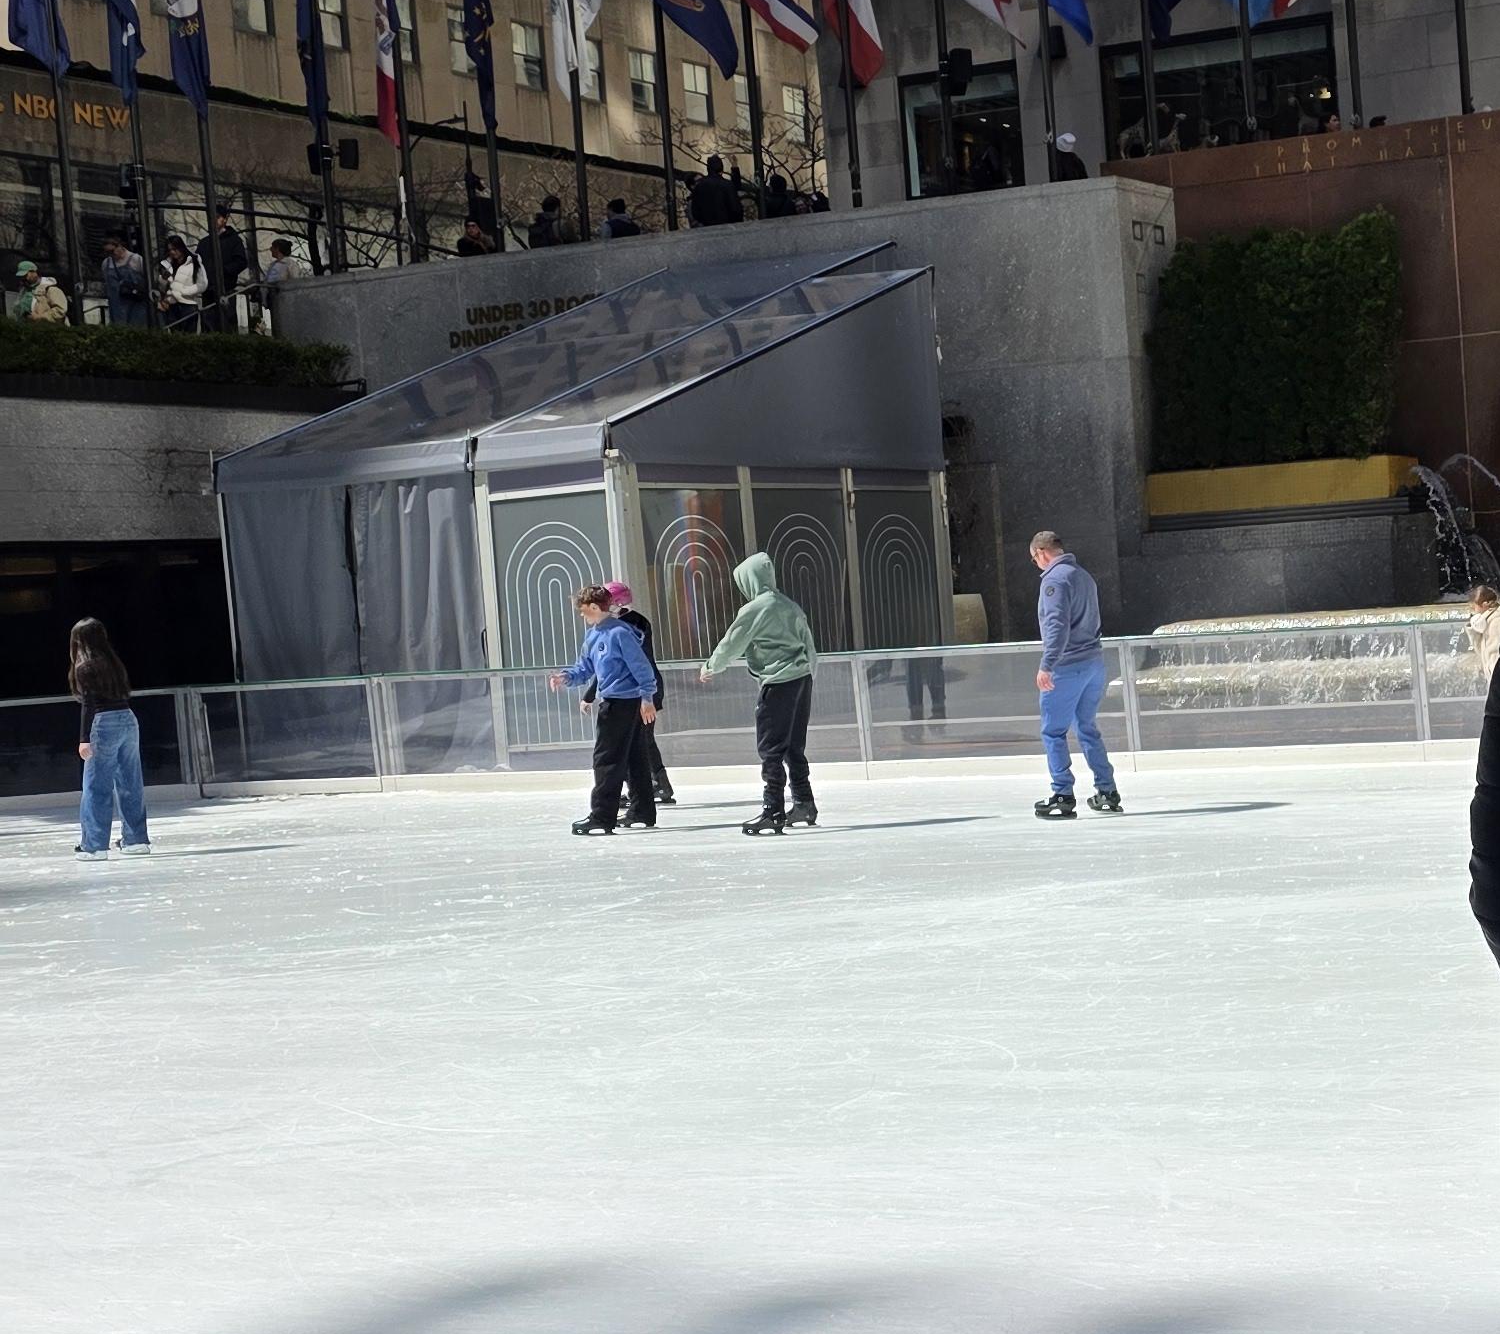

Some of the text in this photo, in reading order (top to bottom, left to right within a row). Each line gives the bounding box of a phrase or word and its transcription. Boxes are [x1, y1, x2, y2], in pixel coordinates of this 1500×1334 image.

[73, 100, 130, 131] NEW
[1379, 138, 1466, 160] HATH
[466, 293, 604, 325] UNDER 30 RO
[449, 325, 510, 349] DINING
